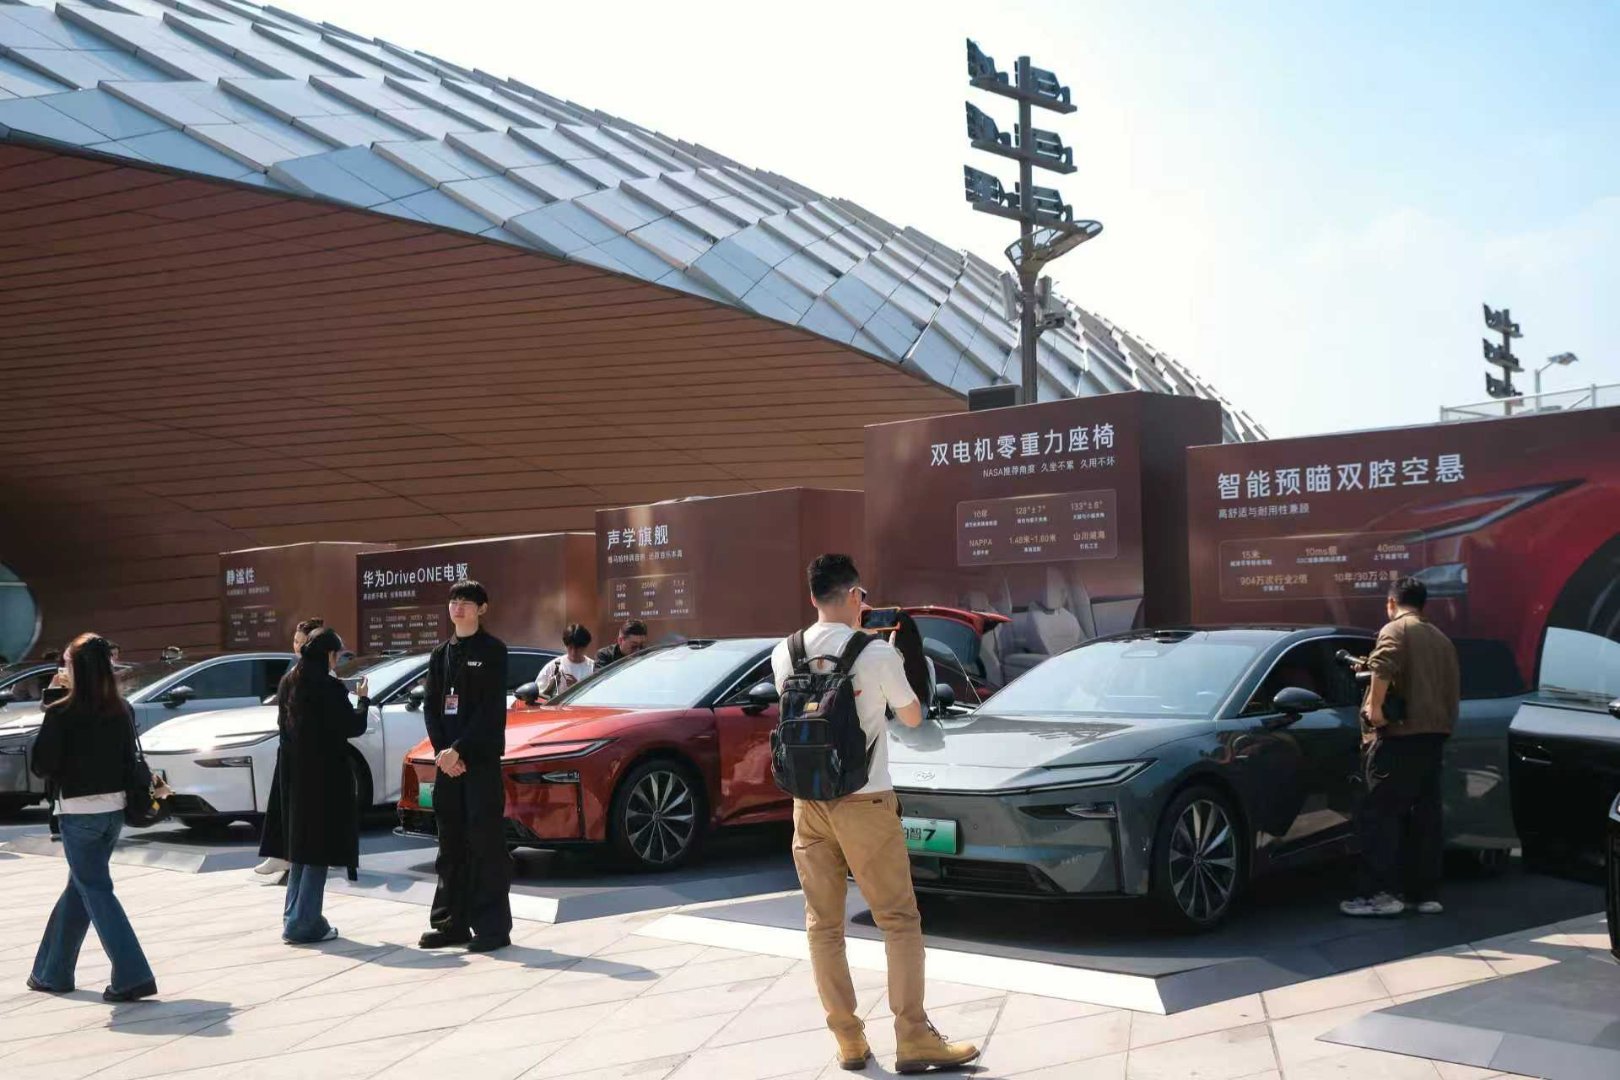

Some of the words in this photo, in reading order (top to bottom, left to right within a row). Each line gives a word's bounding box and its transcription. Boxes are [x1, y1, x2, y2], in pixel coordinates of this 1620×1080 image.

[930, 422, 1115, 467] 双电机零重力座椅
[1080, 456, 1115, 469] 久用不坏
[1217, 453, 1465, 500] 智能预瞄双腔空悬
[1218, 503, 1310, 519] 高舒适与耐用性兼顾
[607, 524, 669, 550] 声学旗舰
[969, 539, 993, 548] NAPPA
[363, 563, 468, 588] 华为DriveONE电驱
